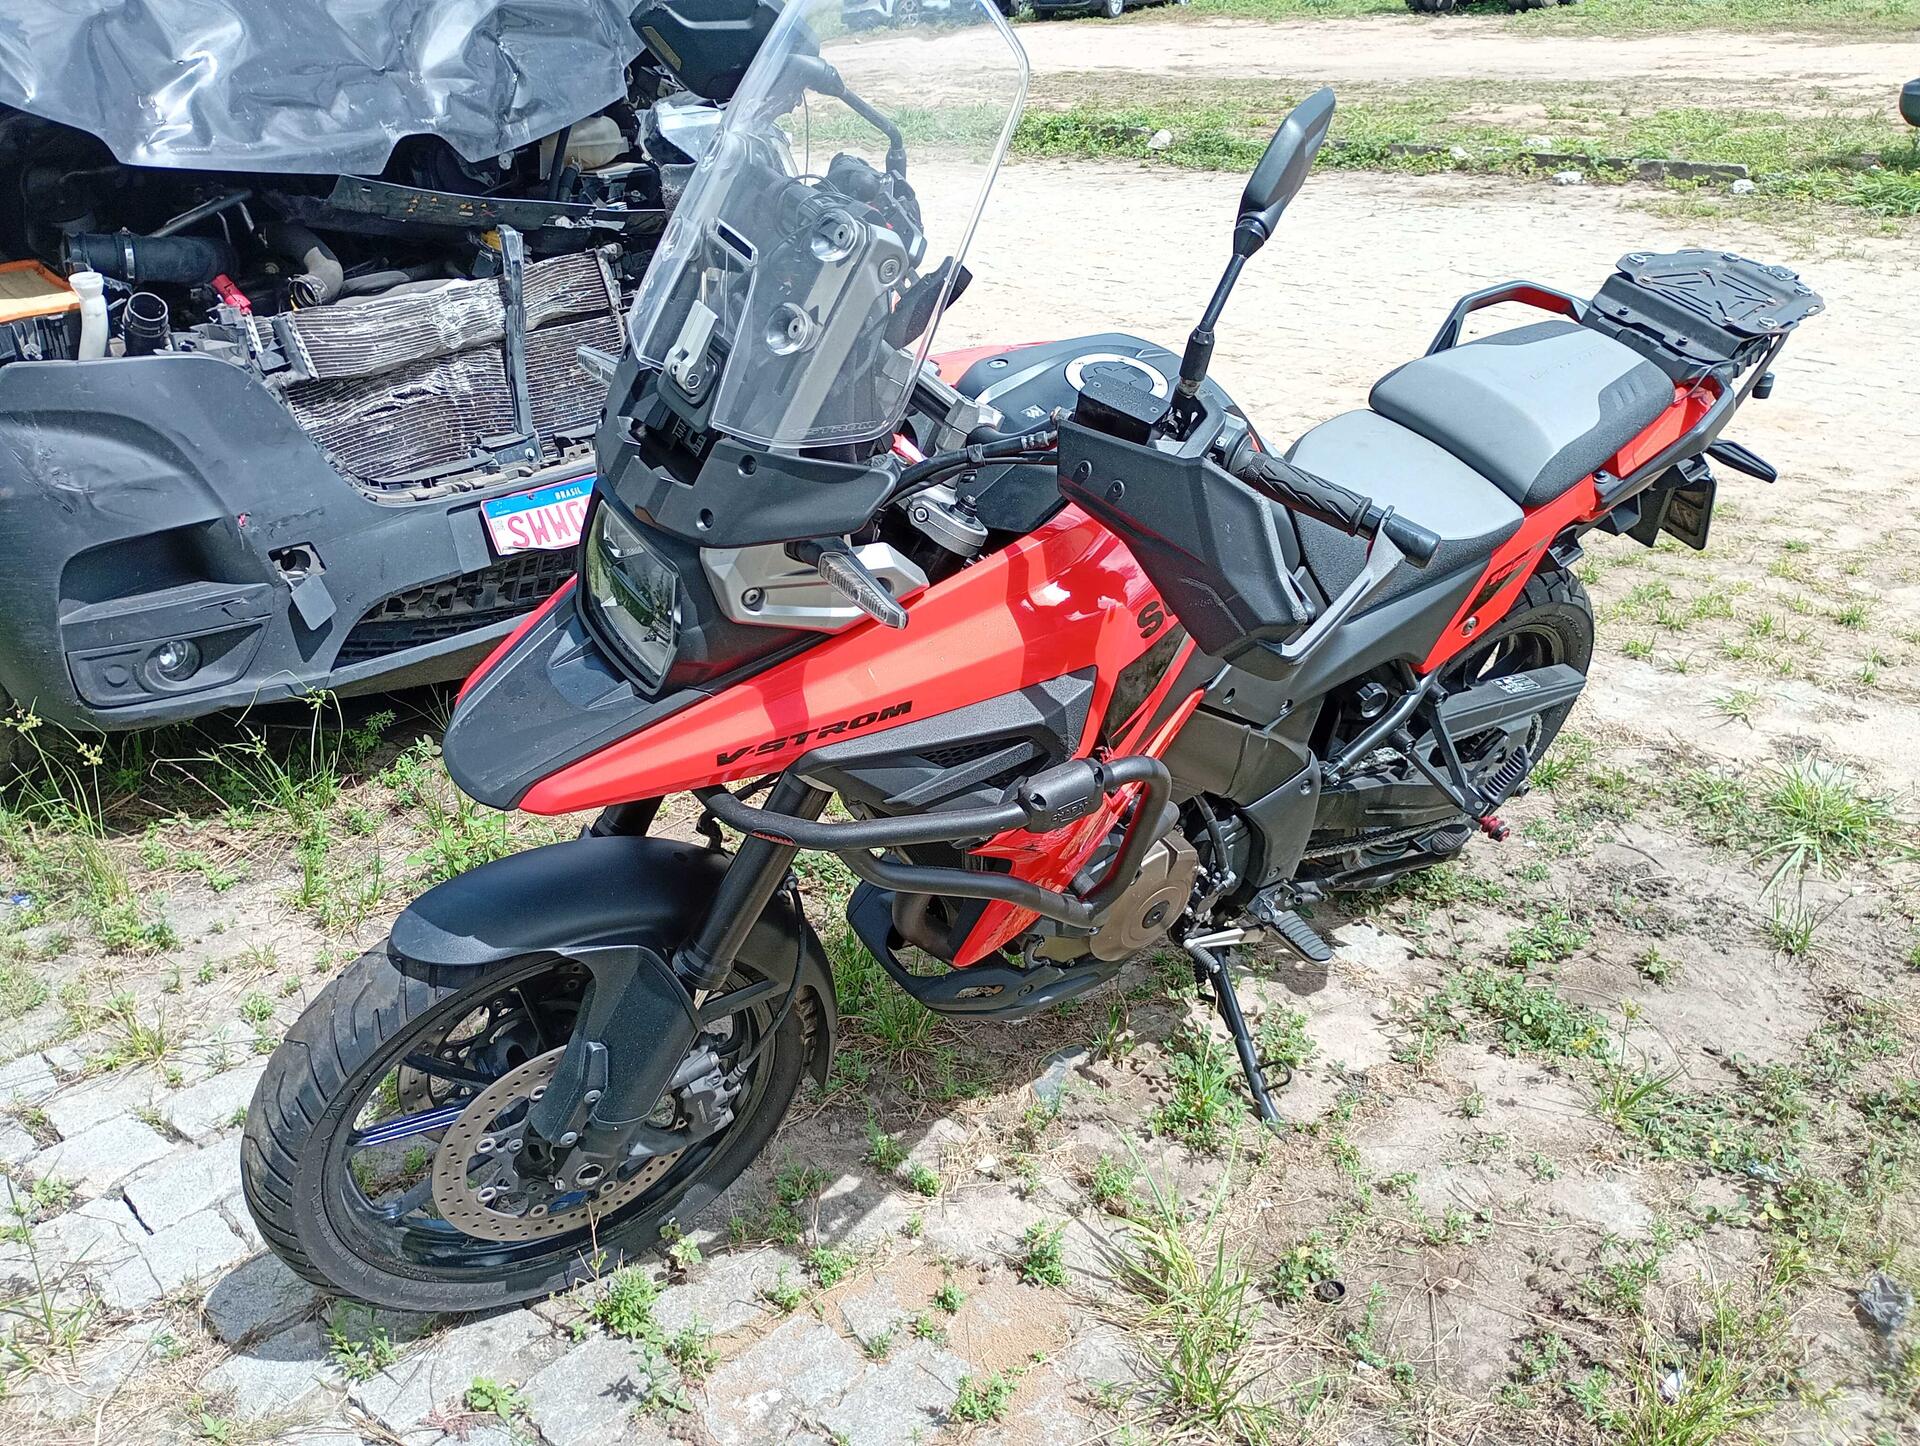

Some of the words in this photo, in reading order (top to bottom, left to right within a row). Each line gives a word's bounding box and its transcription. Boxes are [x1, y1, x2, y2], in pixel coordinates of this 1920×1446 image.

[554, 486, 583, 500] BRASIL
[507, 497, 590, 547] SWW0
[716, 700, 913, 767] V-STROM
